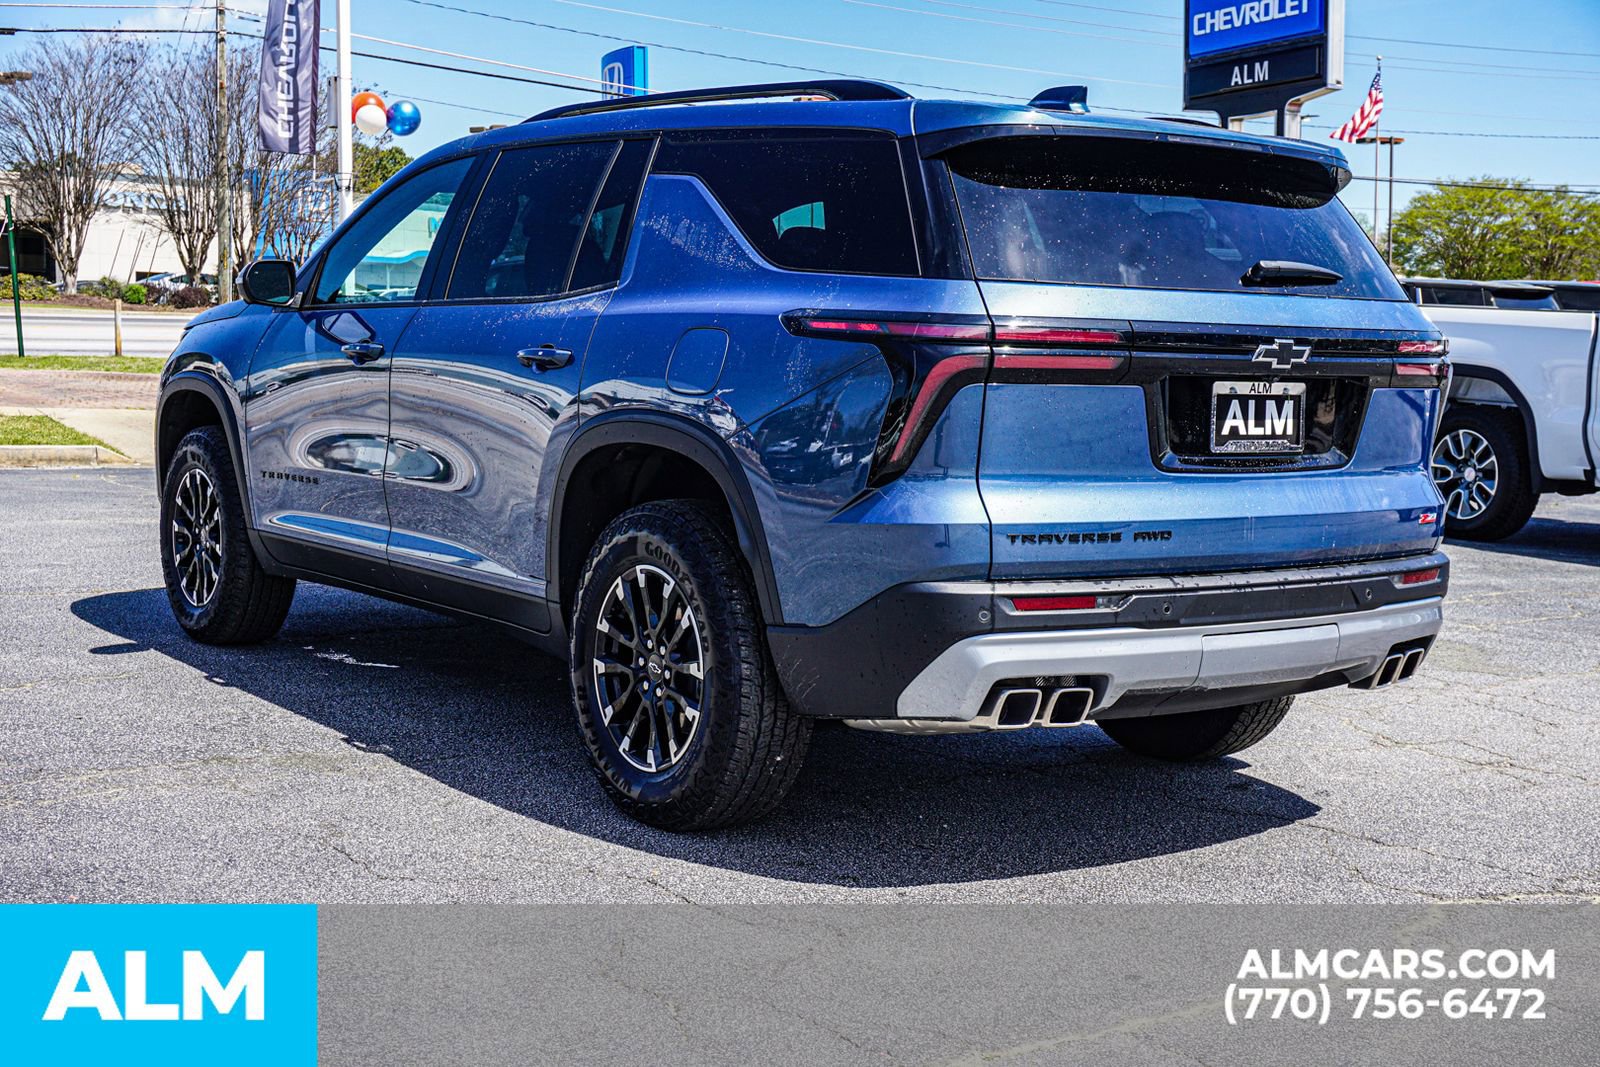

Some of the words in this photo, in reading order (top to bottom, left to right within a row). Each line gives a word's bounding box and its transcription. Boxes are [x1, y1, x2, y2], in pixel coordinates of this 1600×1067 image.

[1230, 60, 1269, 86] ALM
[1249, 383, 1272, 393] ALM
[1221, 399, 1294, 435] ALM
[261, 471, 319, 485] TRAVERSE
[1007, 532, 1122, 545] TRAVERSE
[1133, 530, 1172, 542] AWD
